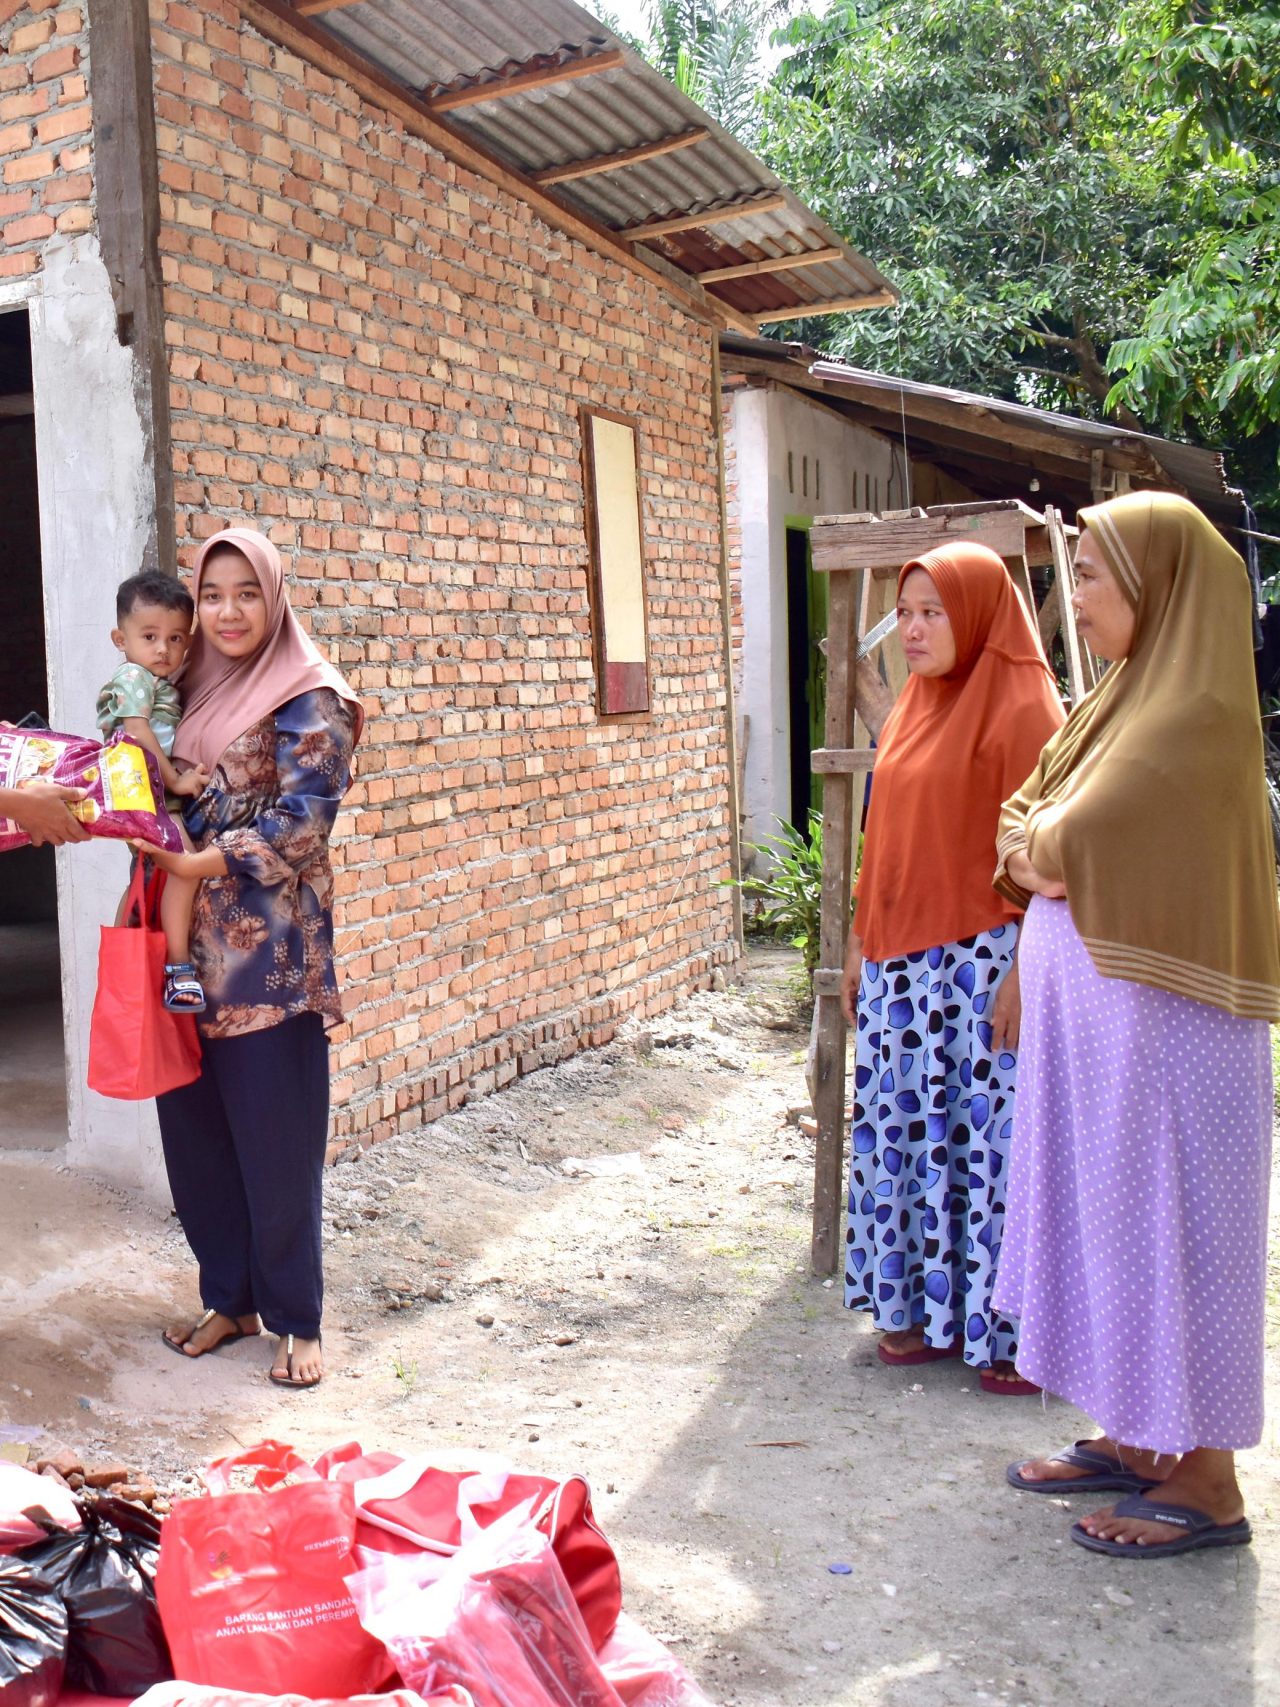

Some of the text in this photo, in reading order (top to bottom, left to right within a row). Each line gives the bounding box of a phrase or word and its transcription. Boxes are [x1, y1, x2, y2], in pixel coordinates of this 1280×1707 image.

[225, 1612, 265, 1625] BARANG
[267, 1606, 313, 1621] BANTUAN
[216, 1625, 245, 1638] ANAK
[247, 1621, 292, 1634] LAKI-LAKI
[293, 1616, 314, 1629] DAN
